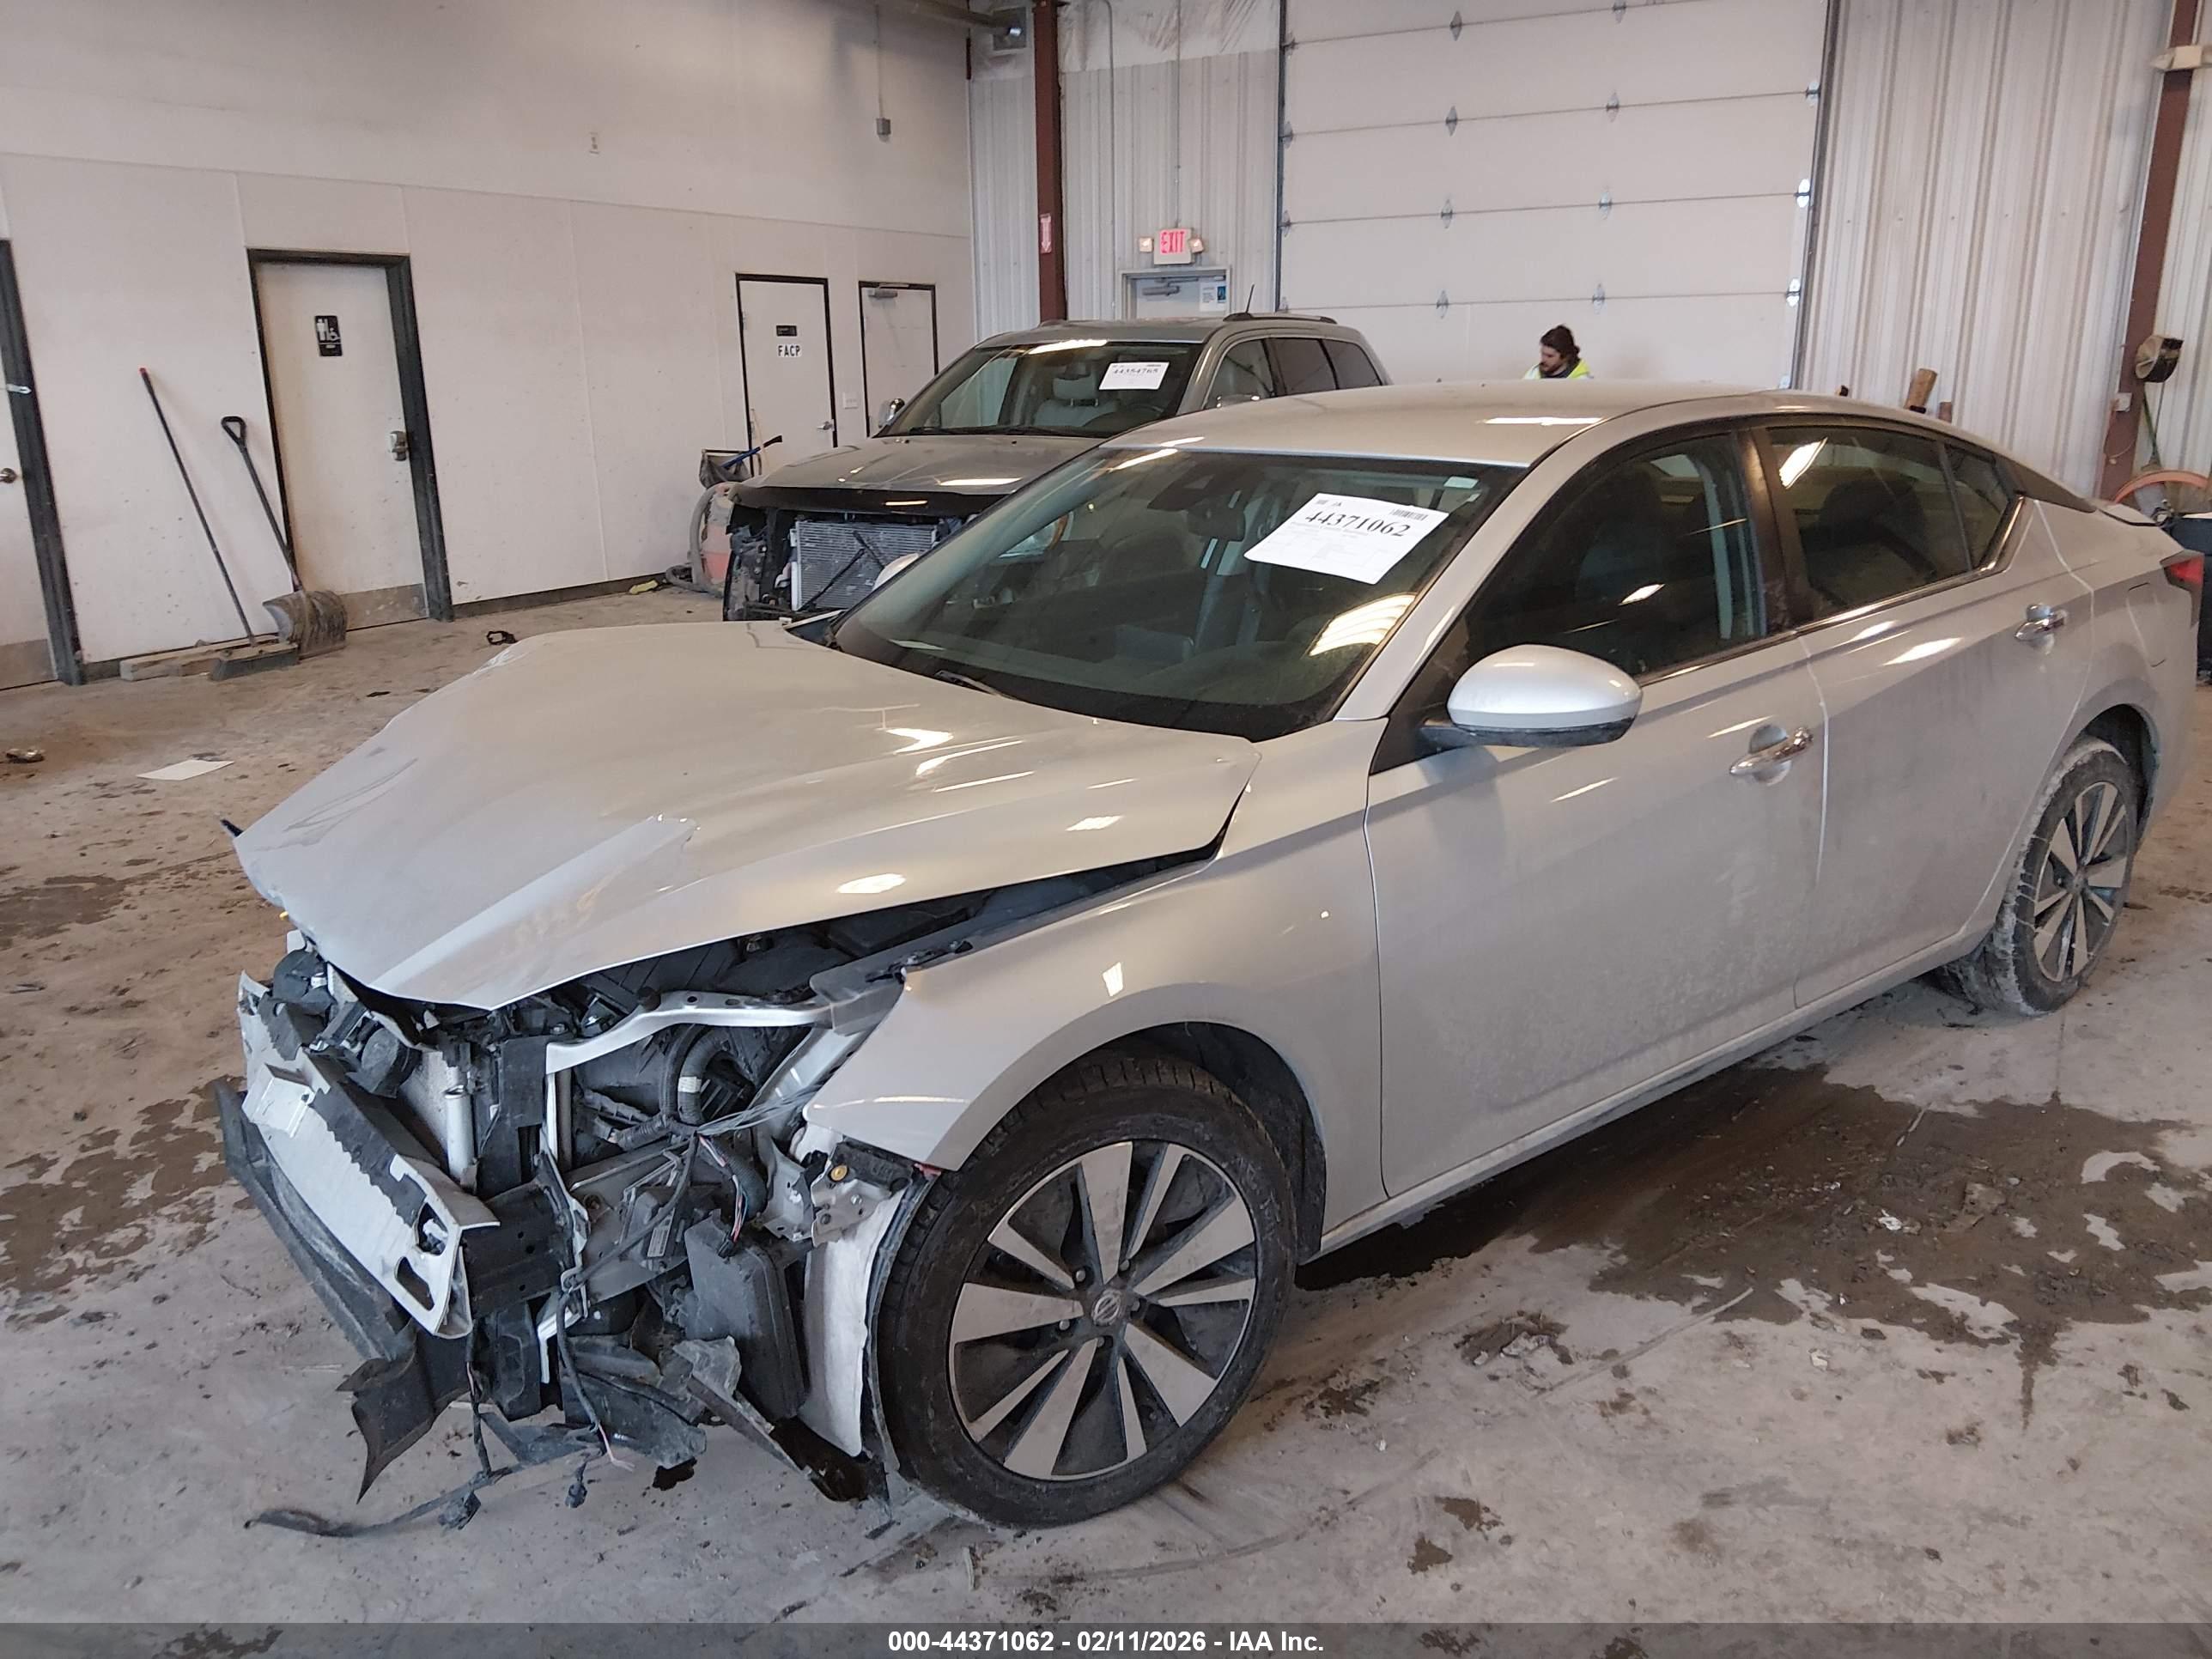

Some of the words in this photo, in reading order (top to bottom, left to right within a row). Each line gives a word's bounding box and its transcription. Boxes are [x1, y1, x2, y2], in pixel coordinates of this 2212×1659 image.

[1160, 231, 1185, 254] EXIT
[777, 344, 800, 356] FACP
[1304, 511, 1411, 537] 44371062
